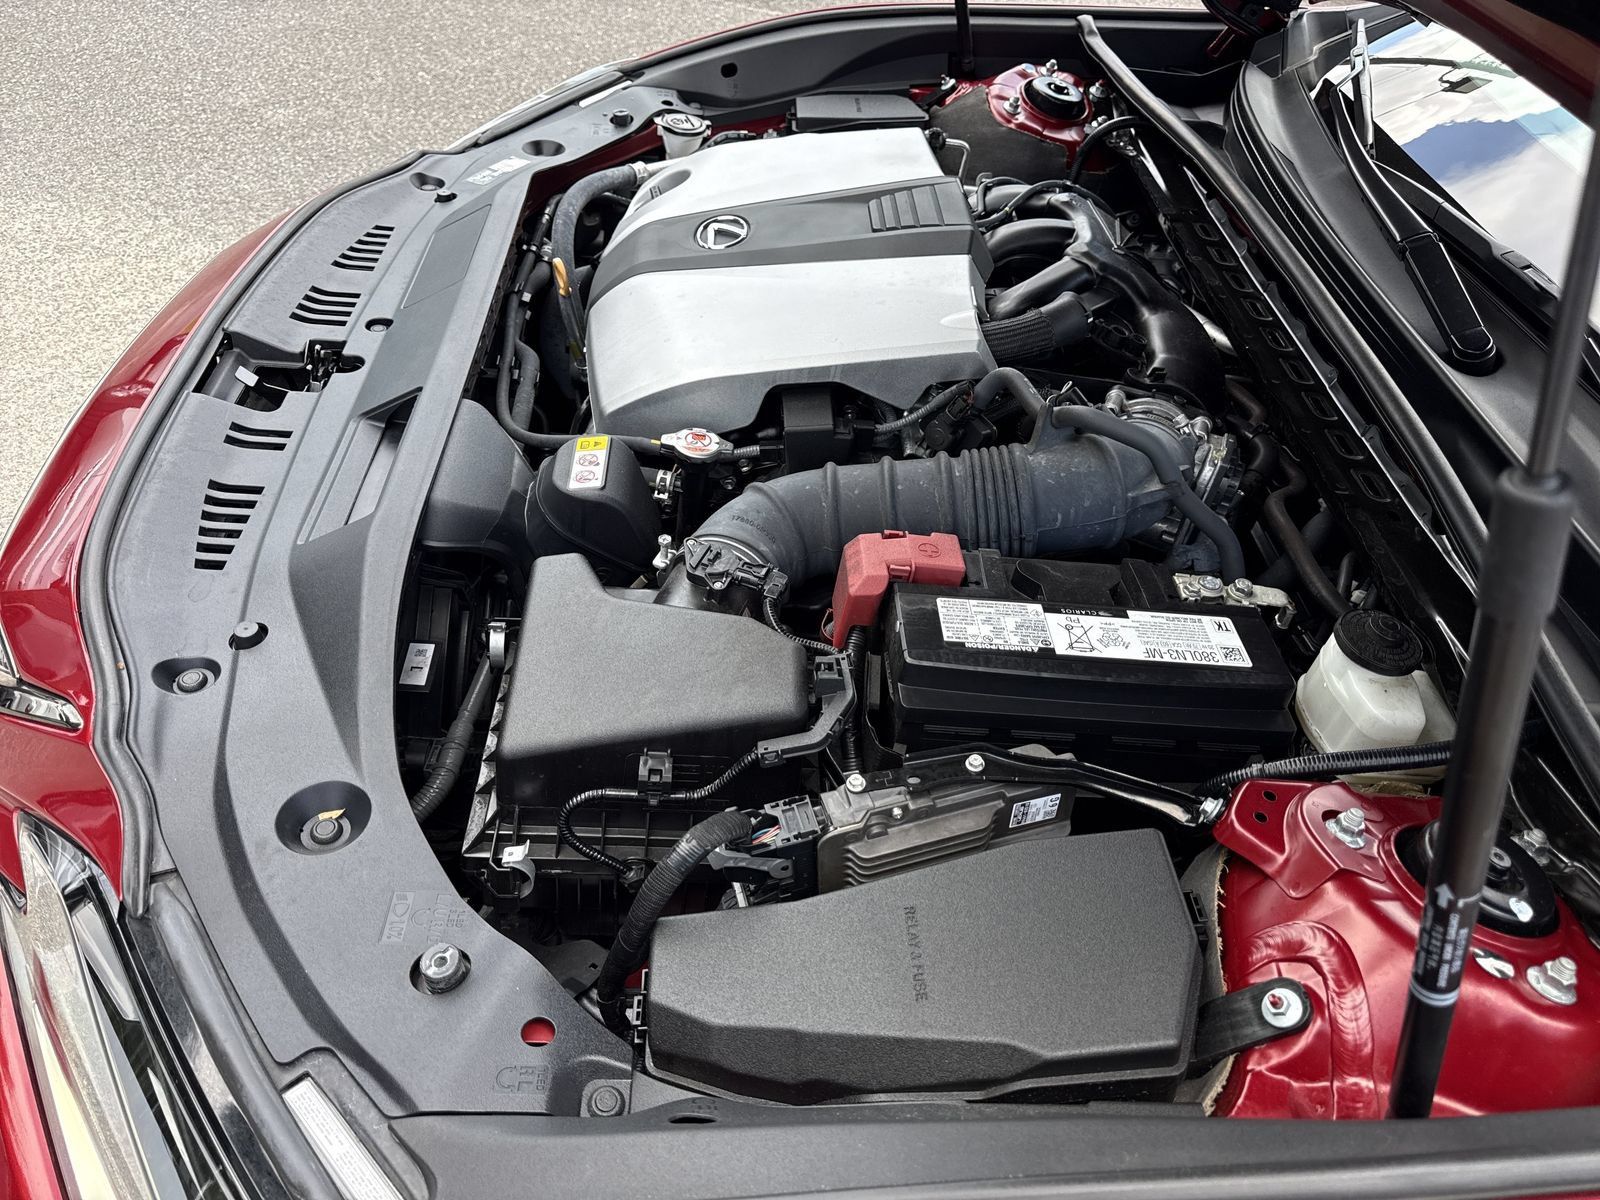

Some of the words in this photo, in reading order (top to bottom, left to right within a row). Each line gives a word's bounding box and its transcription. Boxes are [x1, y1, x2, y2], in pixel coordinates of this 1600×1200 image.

[1060, 607, 1096, 615] CLARIOS
[1065, 615, 1080, 623] Pb
[1213, 620, 1230, 631] TK
[964, 642, 1031, 651] DANGER/POISON
[1143, 647, 1219, 662] 380LN3-MF
[903, 905, 920, 948] RELAY
[911, 965, 927, 1001] FUSE
